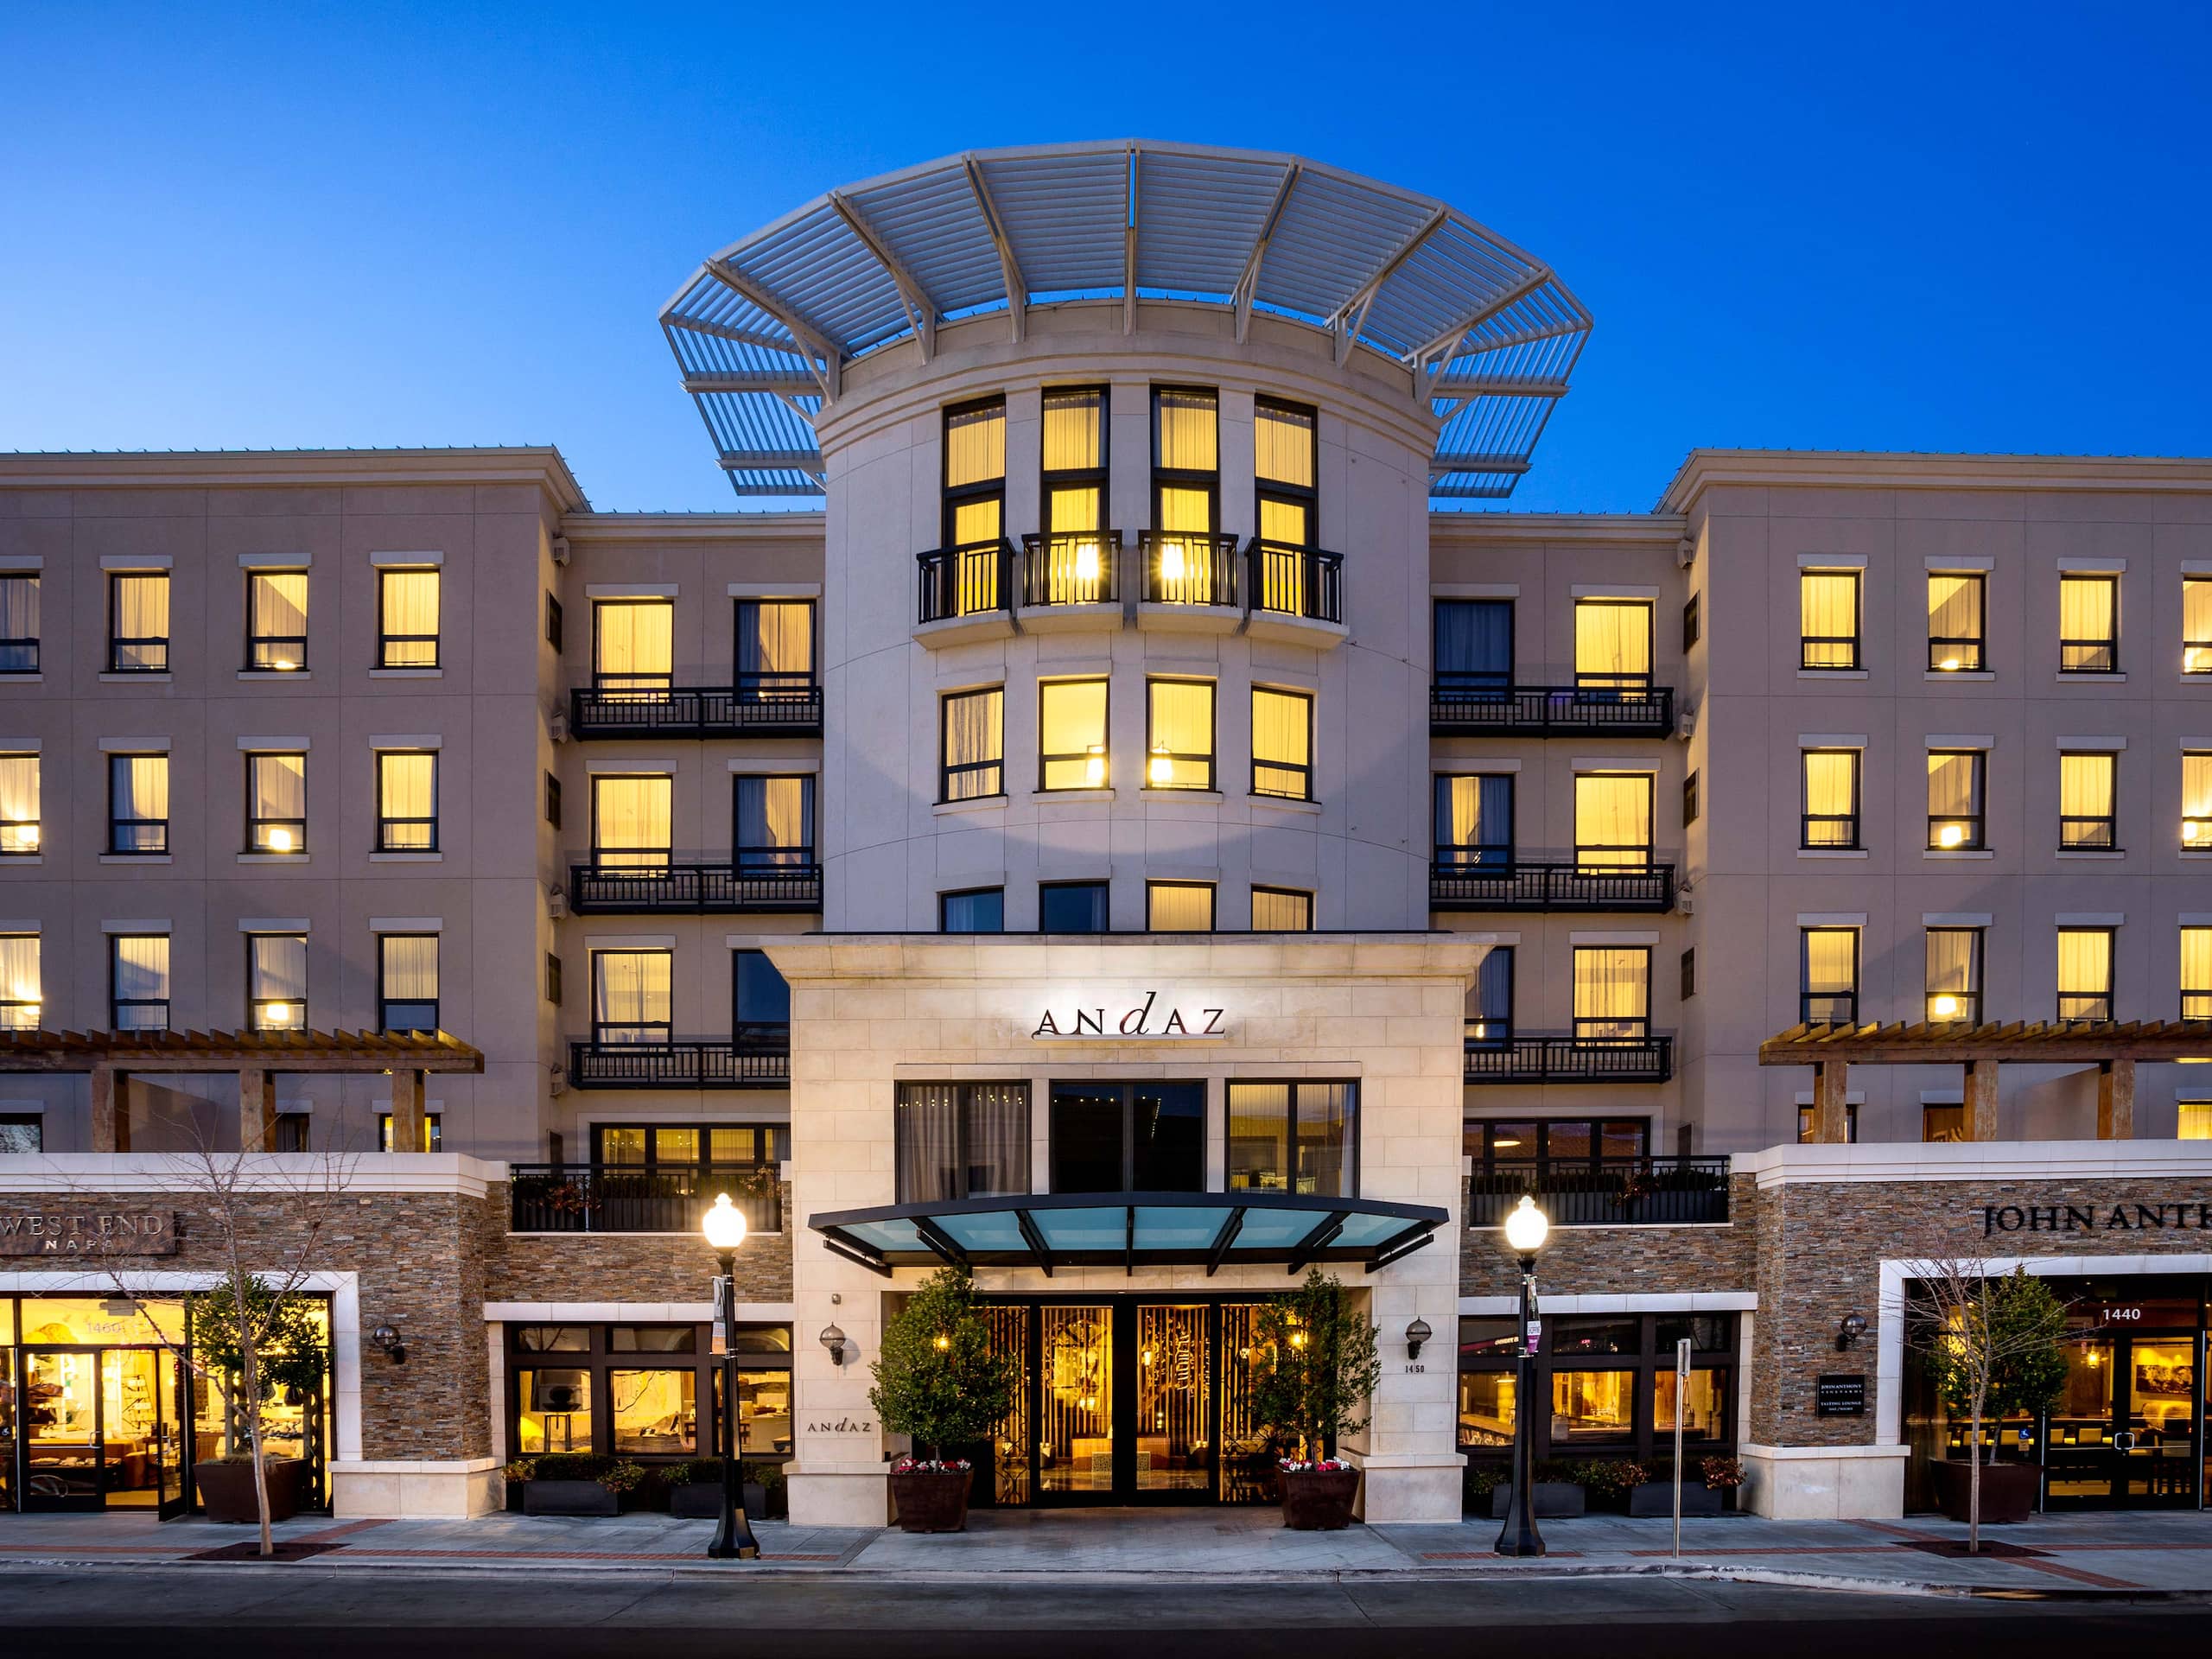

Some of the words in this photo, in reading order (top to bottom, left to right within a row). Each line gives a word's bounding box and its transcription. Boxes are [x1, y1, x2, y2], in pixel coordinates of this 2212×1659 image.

[0, 1216, 86, 1236] WEST
[97, 1215, 164, 1236] END
[1981, 1205, 2095, 1238] JOHN
[46, 1240, 114, 1250] NAPA
[2102, 1308, 2141, 1320] 1440
[86, 1322, 123, 1334] 1460
[1405, 1364, 1425, 1373] 1450
